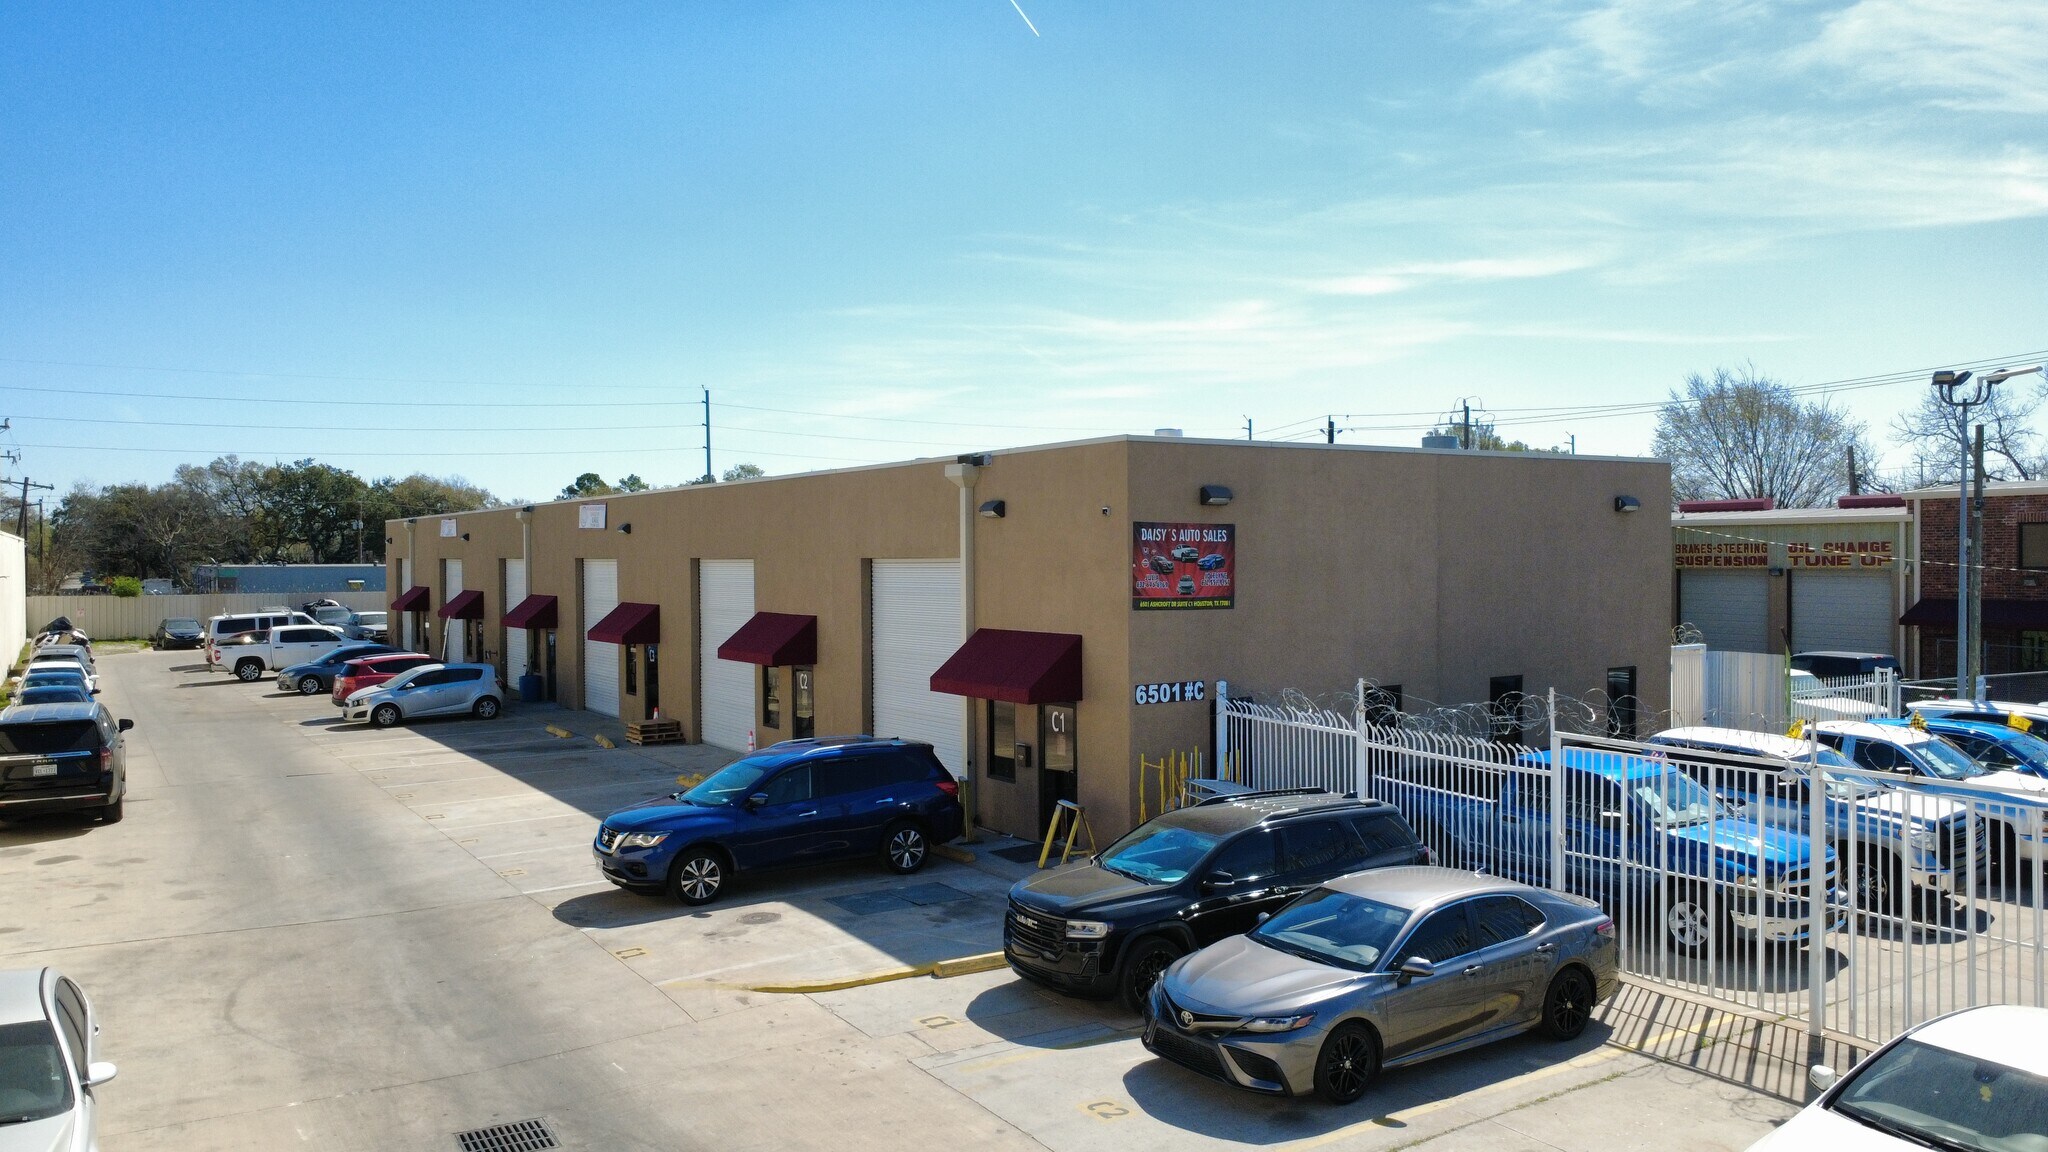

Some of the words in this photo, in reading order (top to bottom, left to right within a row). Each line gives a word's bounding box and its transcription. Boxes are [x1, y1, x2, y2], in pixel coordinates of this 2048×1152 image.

[1179, 529, 1200, 541] AUTO
[1203, 529, 1227, 542] SALES
[1675, 543, 1768, 554] BRAKES-STEERING
[1787, 542, 1815, 553] OIL
[1823, 541, 1892, 553] CHANGE
[1675, 556, 1768, 567] SUSPENSION
[1788, 555, 1851, 567] TUNE
[1861, 555, 1893, 567] UP
[800, 673, 808, 690] C2
[1051, 711, 1065, 733] C1
[1087, 1101, 1130, 1119] C2
